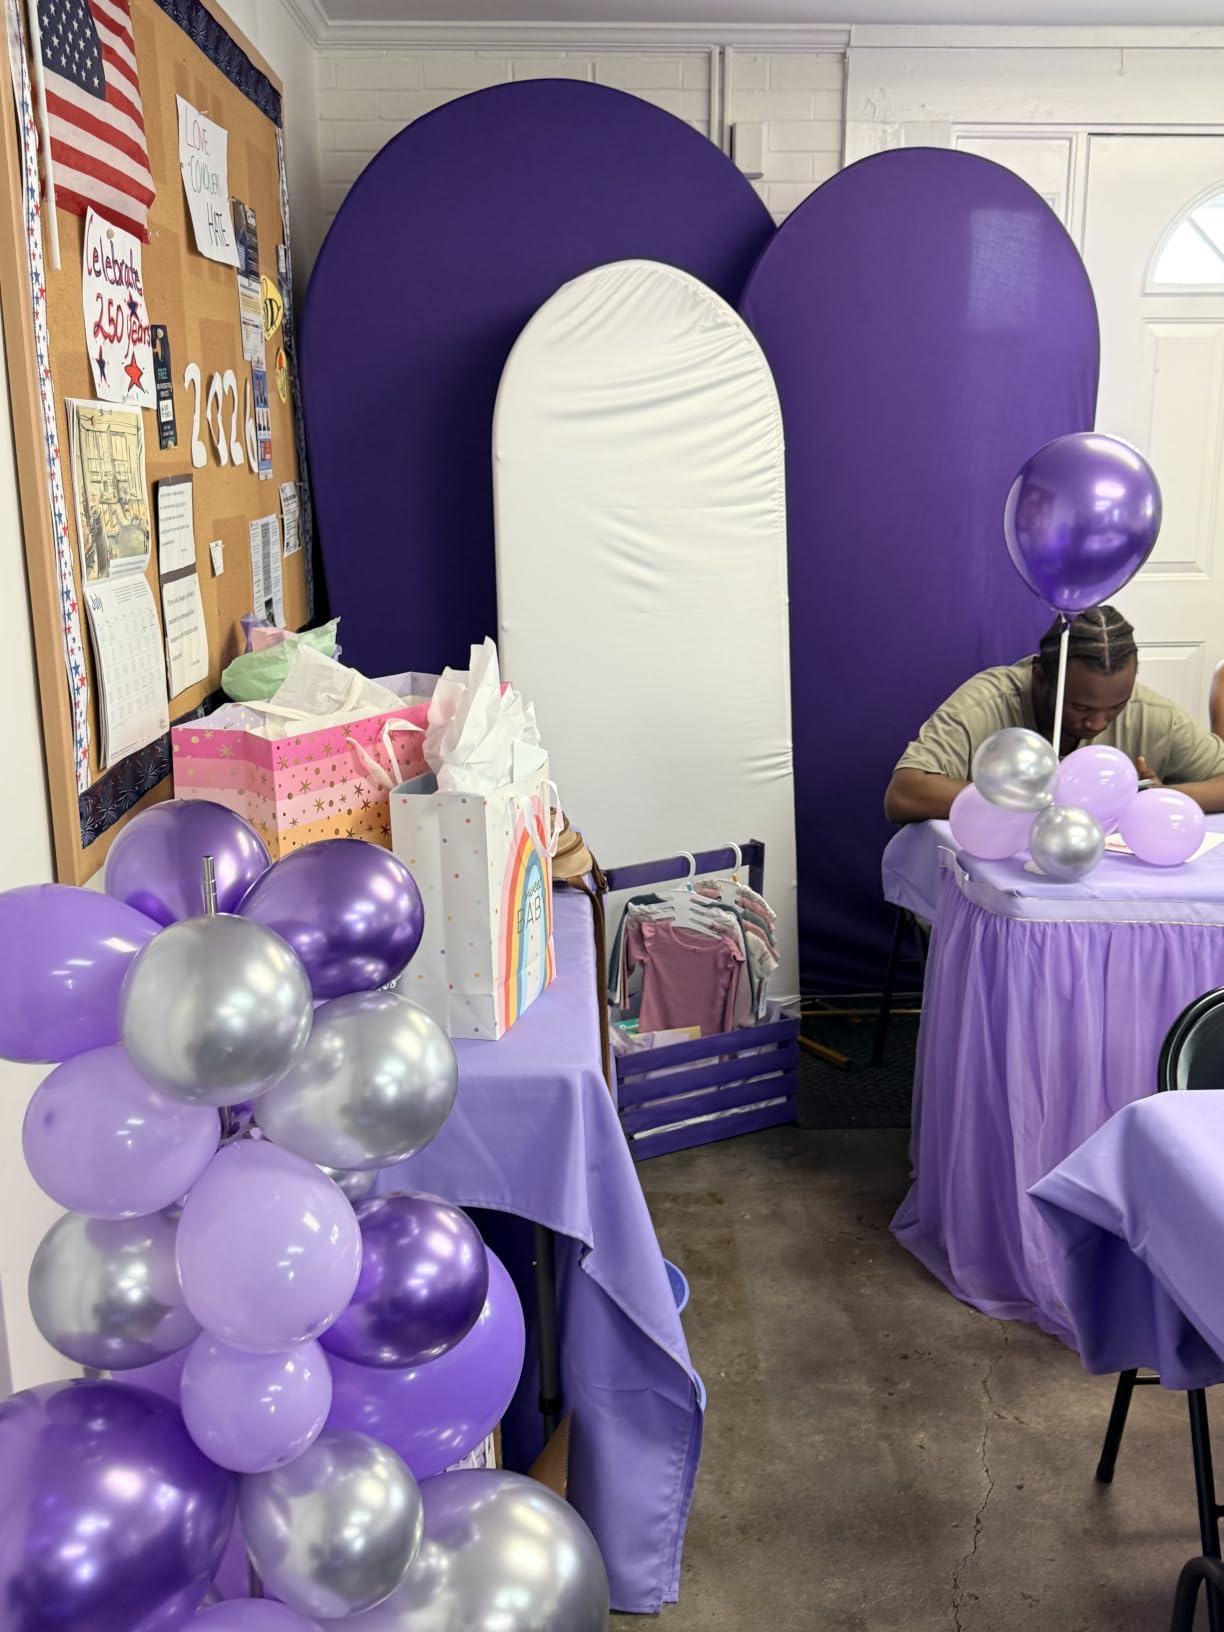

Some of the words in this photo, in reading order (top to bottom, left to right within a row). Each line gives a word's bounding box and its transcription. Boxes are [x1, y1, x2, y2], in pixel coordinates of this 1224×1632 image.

[185, 105, 209, 155] LOVE
[85, 214, 142, 297] Celebrate
[206, 202, 230, 247] HATE
[92, 292, 123, 344] 250
[125, 314, 151, 360] years
[184, 362, 259, 474] 2026
